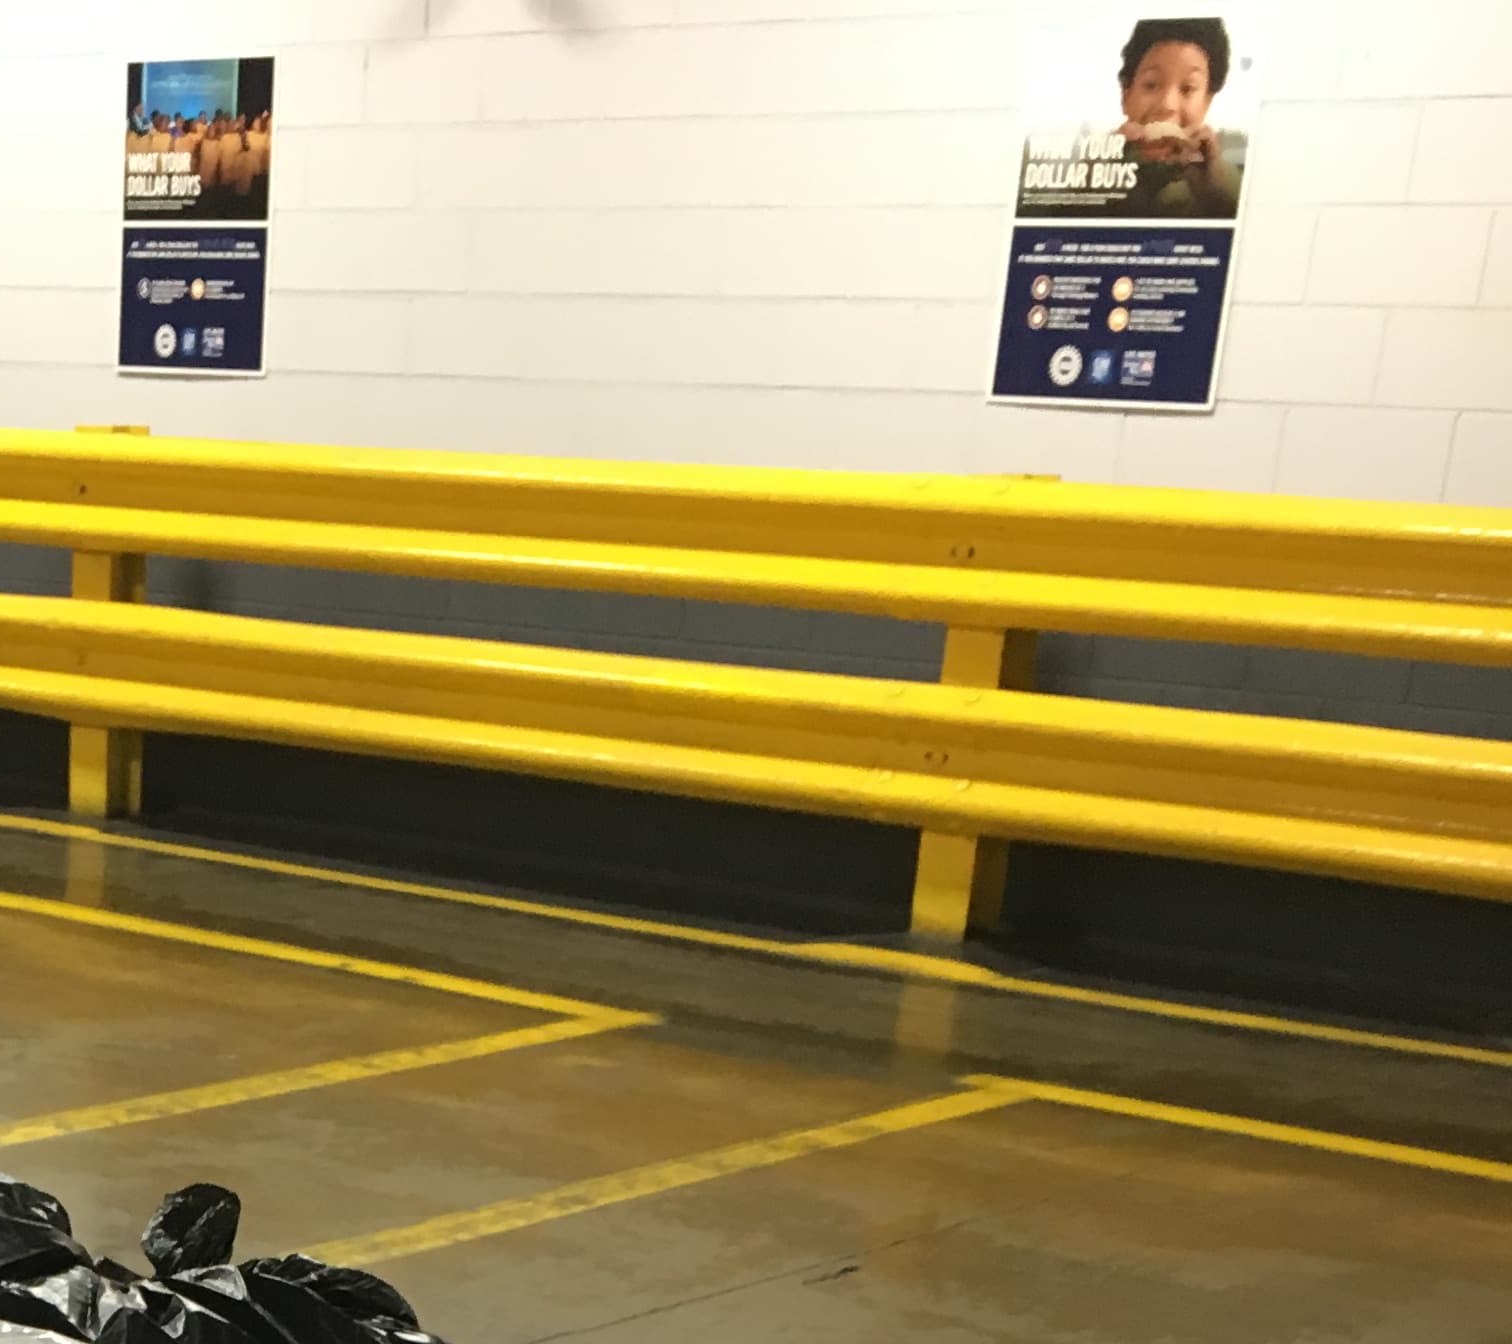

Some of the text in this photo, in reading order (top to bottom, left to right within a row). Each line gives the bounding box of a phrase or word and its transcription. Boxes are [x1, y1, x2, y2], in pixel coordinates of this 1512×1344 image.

[127, 174, 202, 197] DOLLAR BUYS
[1024, 162, 1139, 189] DOLLAR BUYS
